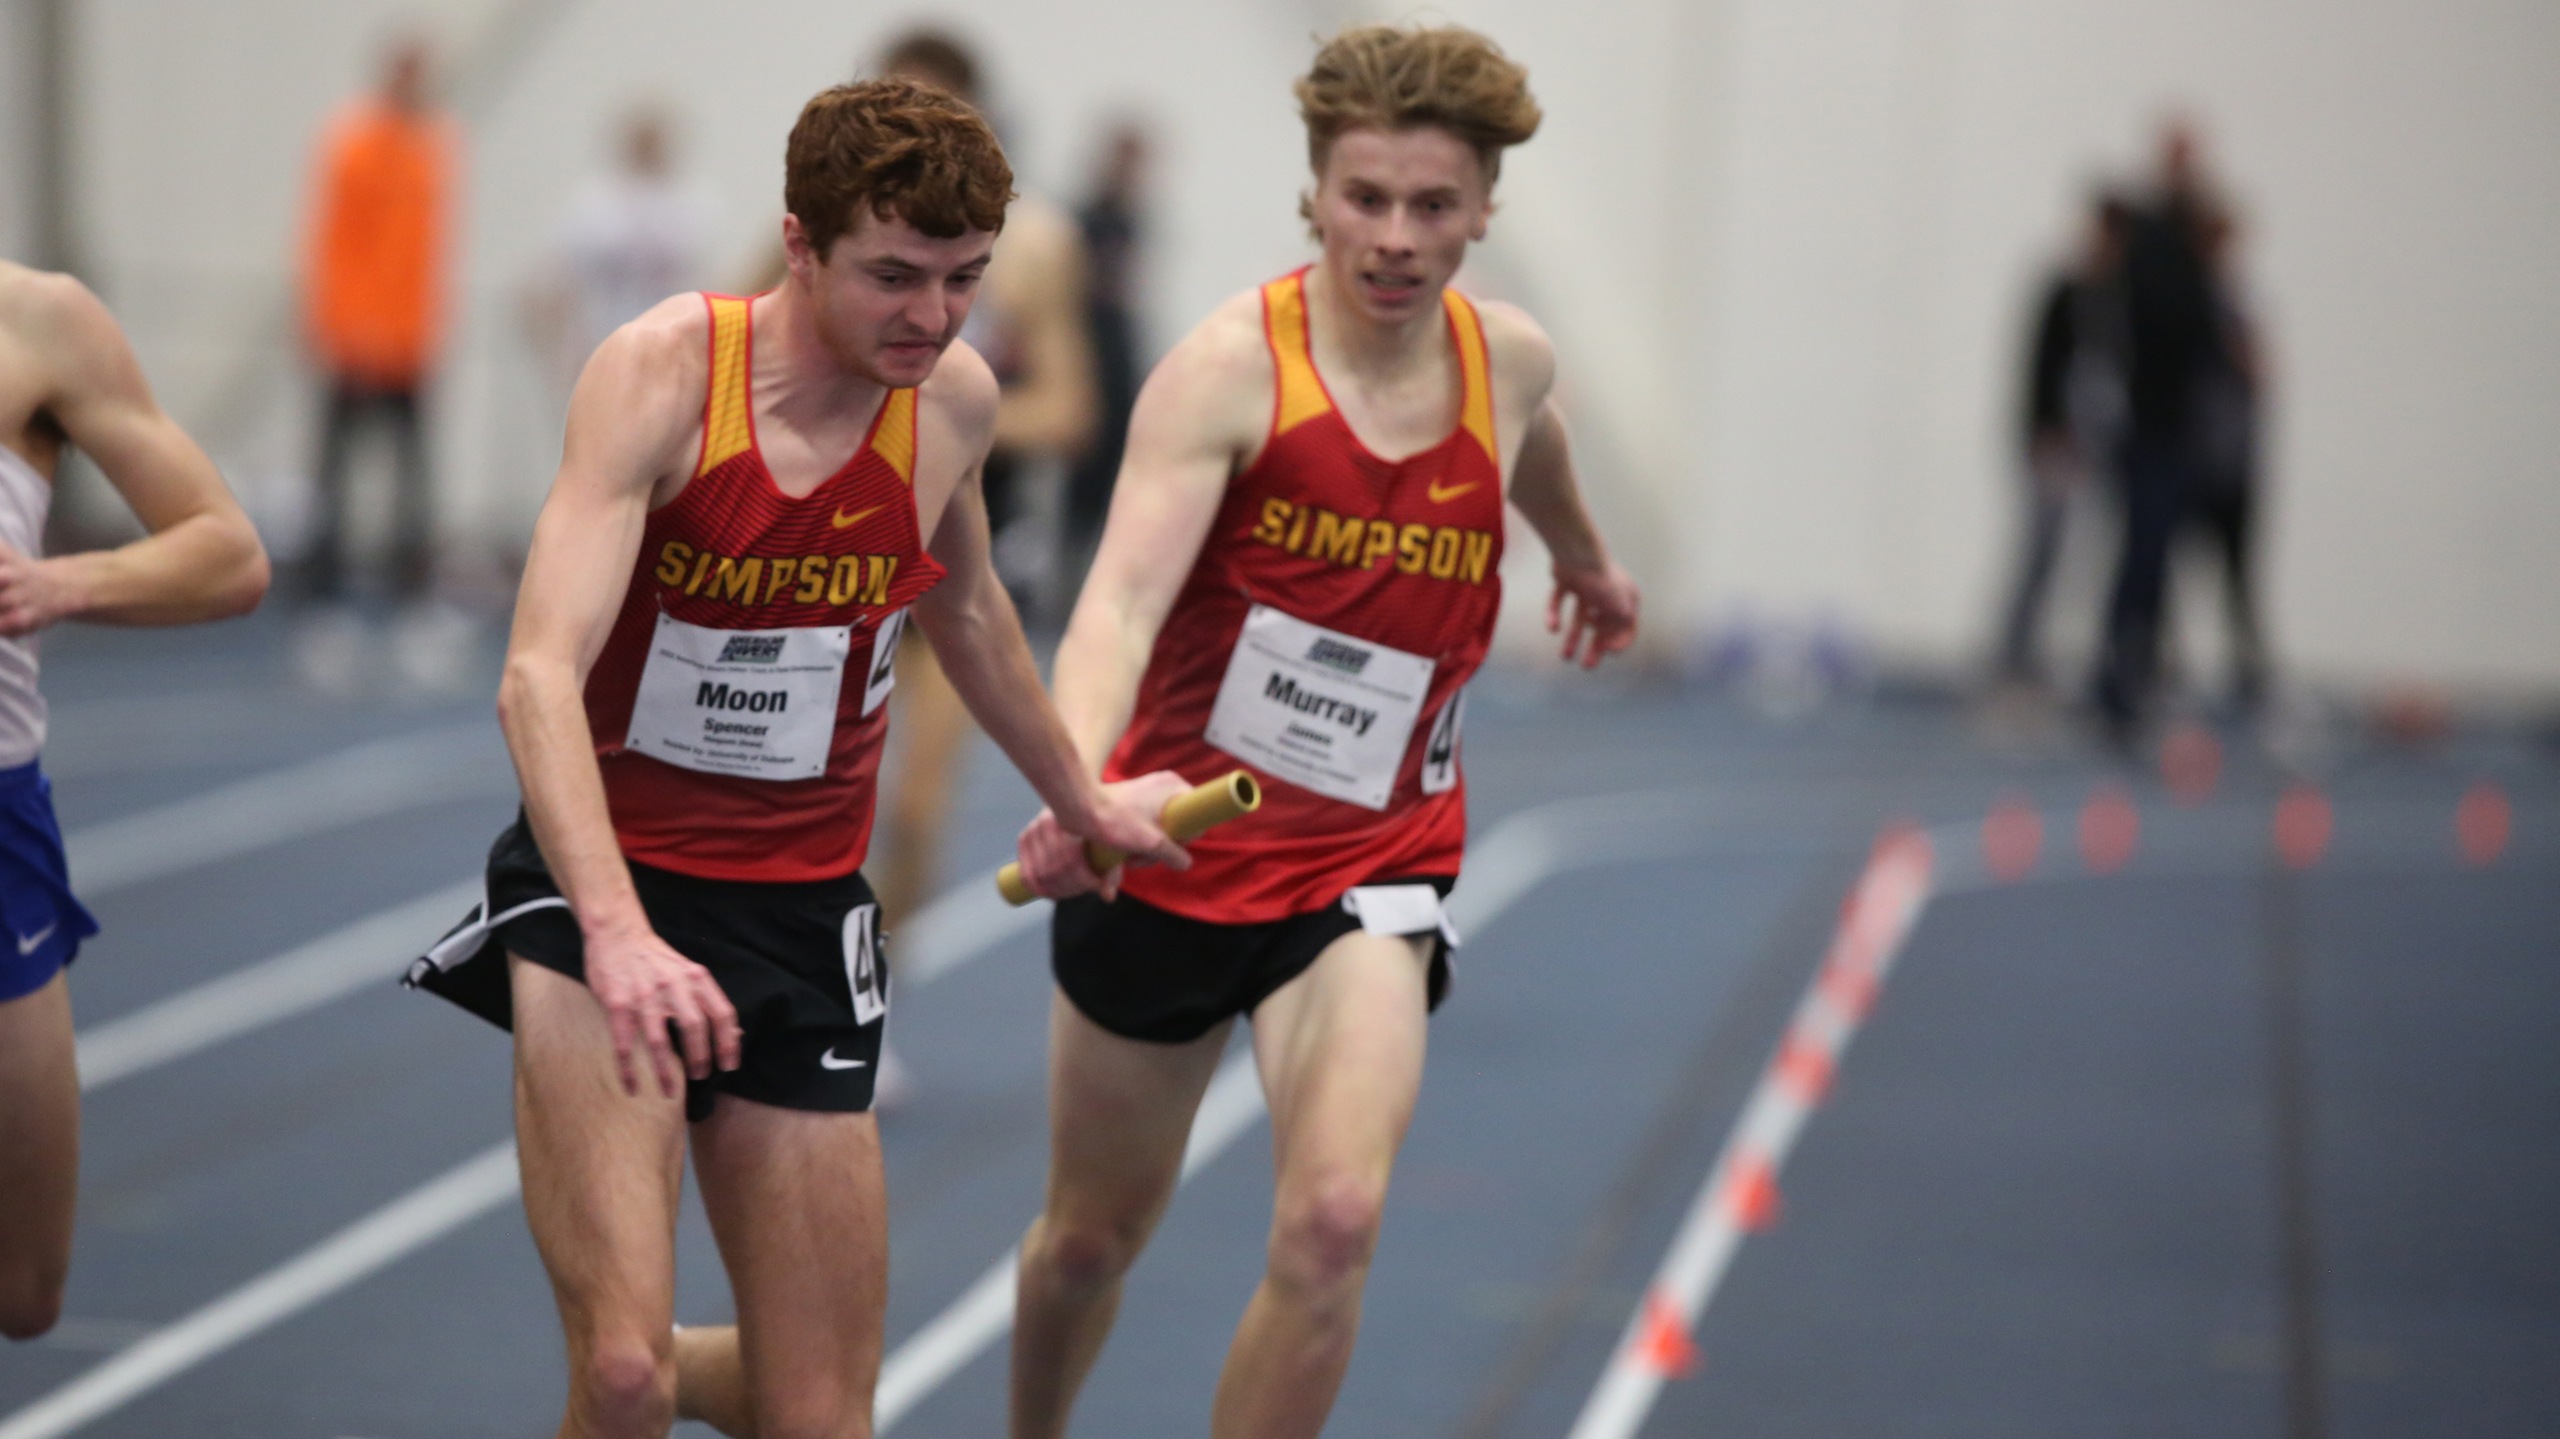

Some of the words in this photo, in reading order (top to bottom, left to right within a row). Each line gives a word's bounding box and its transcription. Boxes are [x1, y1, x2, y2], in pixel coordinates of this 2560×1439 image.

[654, 540, 898, 606] SIMPSON
[1252, 496, 1493, 585] SIMPSON
[696, 680, 789, 713] Moon
[703, 717, 770, 736] Spencer
[1263, 671, 1378, 737] Murray
[1430, 688, 1460, 780] 4
[854, 910, 874, 1007] 4
